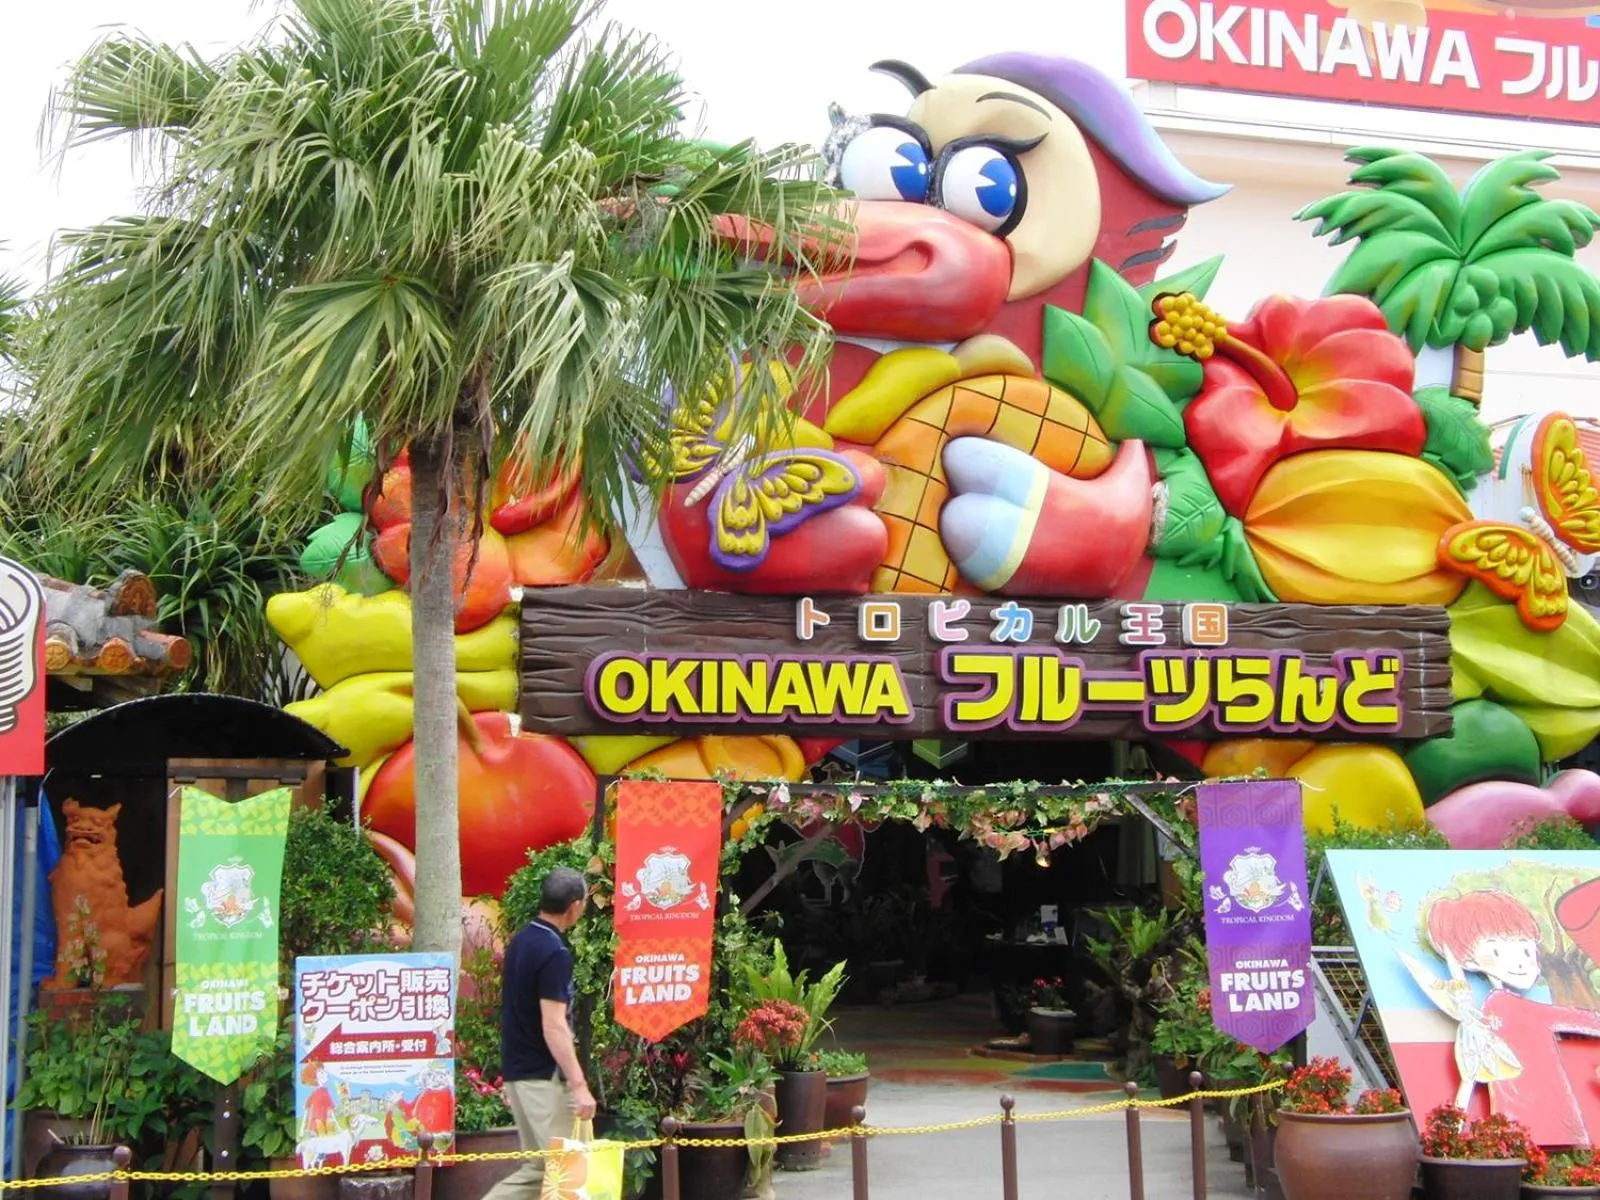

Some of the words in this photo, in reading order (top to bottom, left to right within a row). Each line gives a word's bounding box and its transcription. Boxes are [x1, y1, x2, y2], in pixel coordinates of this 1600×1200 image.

[1142, 0, 1481, 89] OKINAWA
[599, 658, 910, 715] OKINAWA
[953, 656, 1400, 724] フルーツらんど
[635, 953, 685, 964] OKINAWA
[1235, 959, 1288, 969] OKINAWA
[302, 967, 451, 998] チケット販売
[620, 964, 700, 986] FRUITS
[1220, 969, 1305, 993] FRUITS
[625, 984, 692, 1005] LAND
[1229, 992, 1300, 1013] LAND
[301, 995, 451, 1023] クーポン引換
[188, 1014, 257, 1037] LAND
